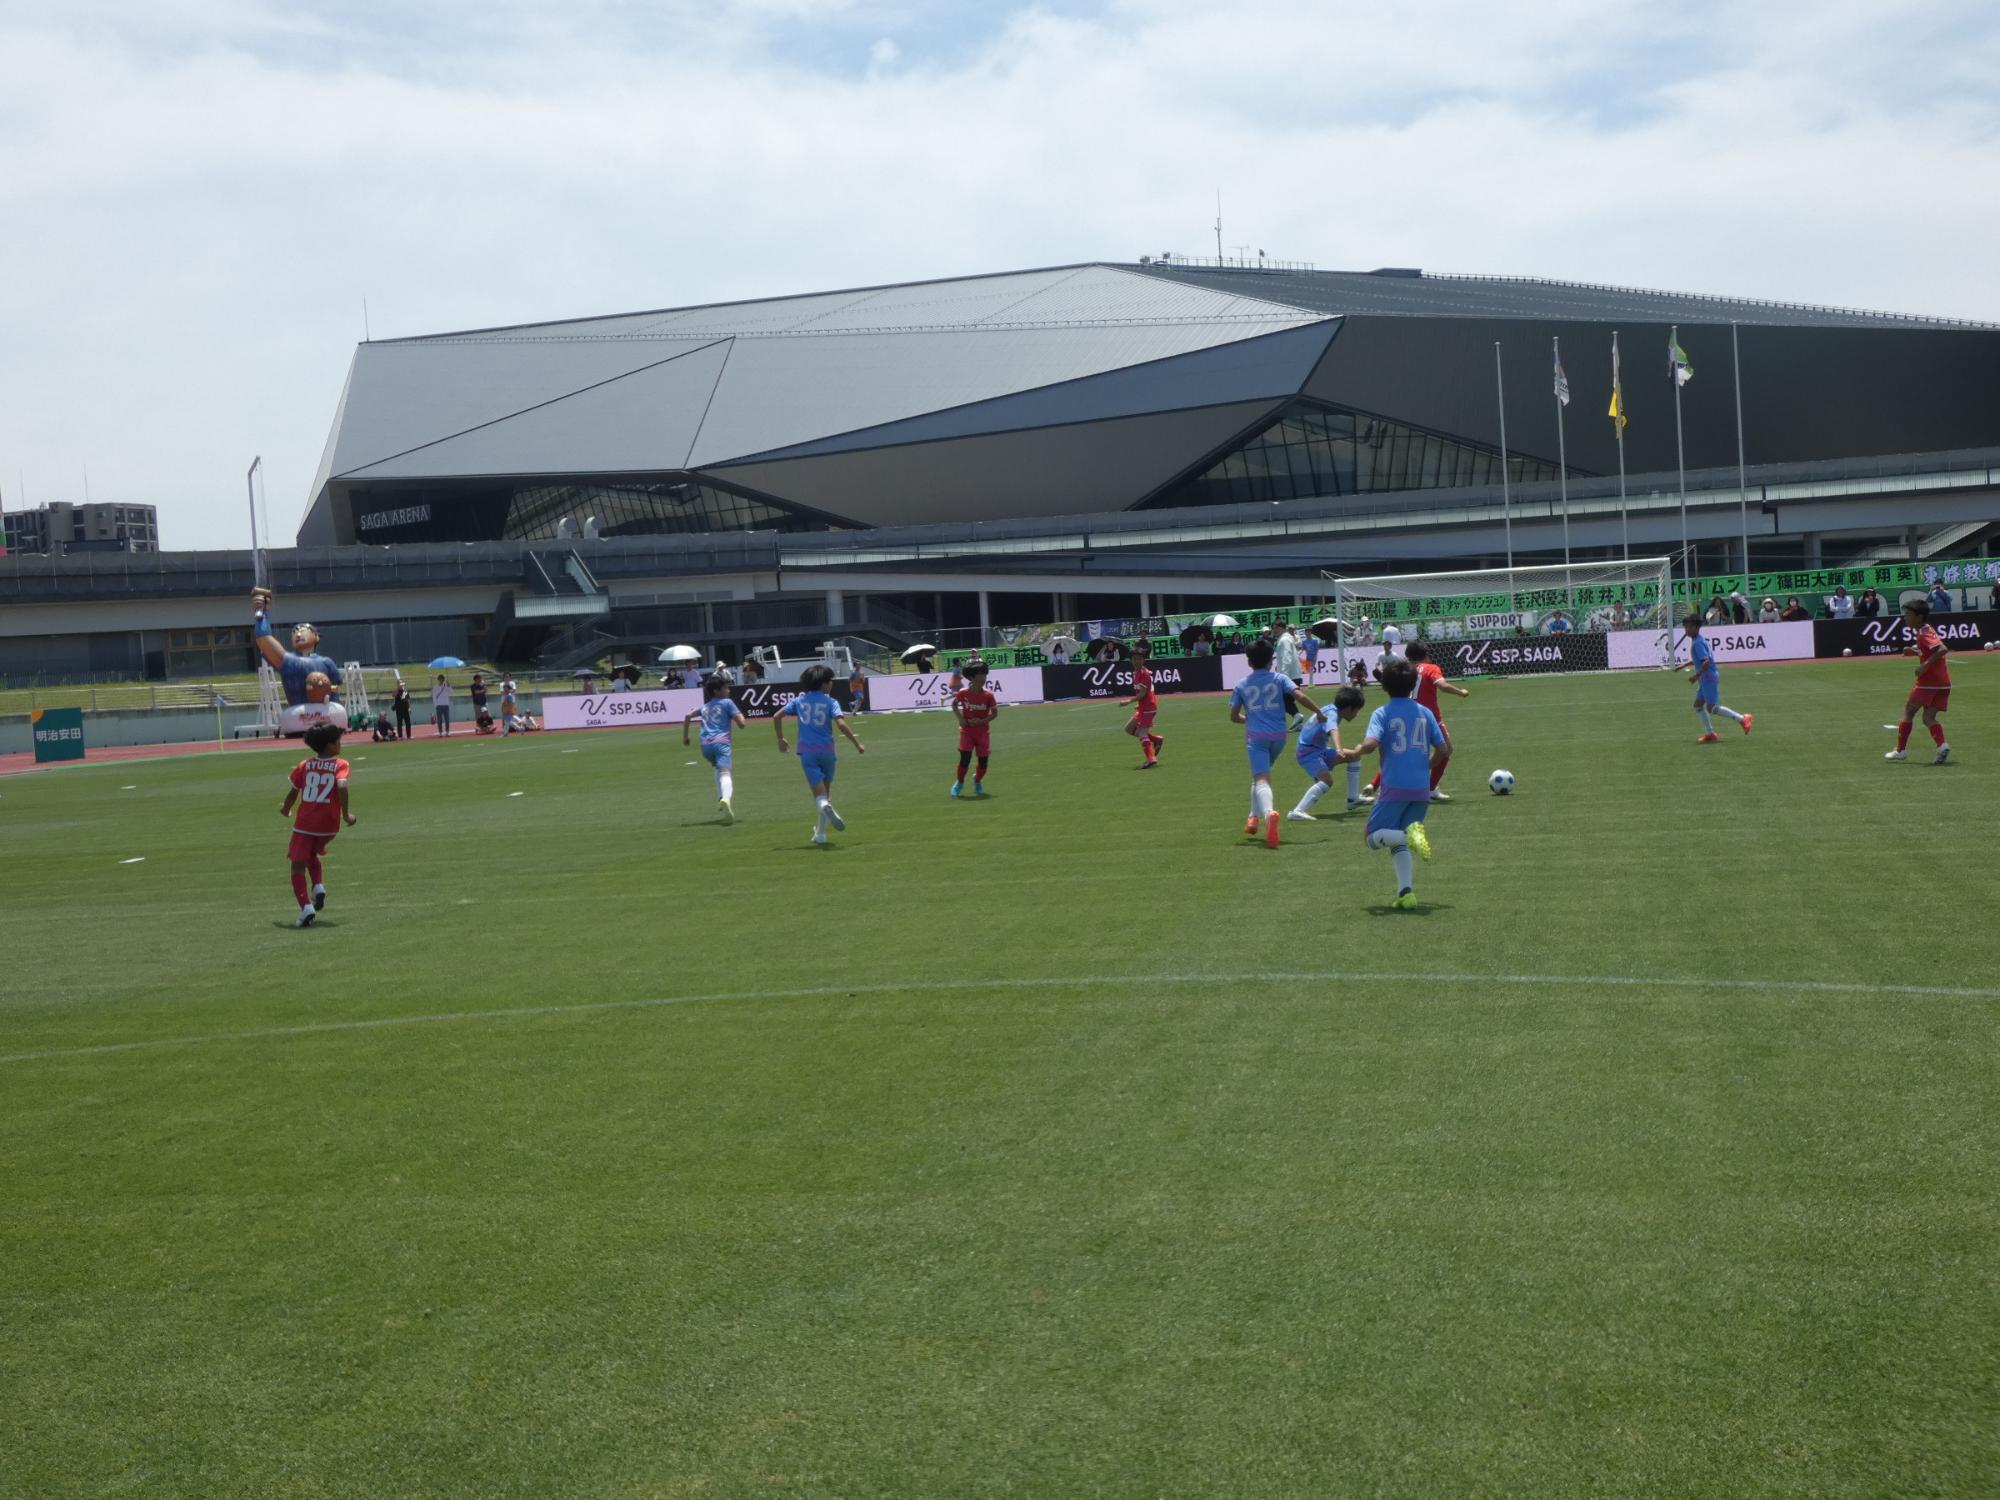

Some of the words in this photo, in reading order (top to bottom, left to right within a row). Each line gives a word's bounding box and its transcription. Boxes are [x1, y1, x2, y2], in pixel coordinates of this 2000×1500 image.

[360, 512, 389, 530] SAGA
[392, 505, 429, 525] ARENA
[1470, 613, 1523, 628] SUPPORT
[1491, 646, 1563, 664] SSP.SAGA
[1870, 645, 1891, 653] SAGA
[1463, 667, 1482, 675] SAGA
[1246, 683, 1280, 711] 22
[609, 701, 667, 715] SSP.SAGA
[801, 703, 827, 726] 35
[35, 728, 81, 742] 明治安田
[1389, 717, 1428, 755] 34
[303, 772, 334, 804] 82
